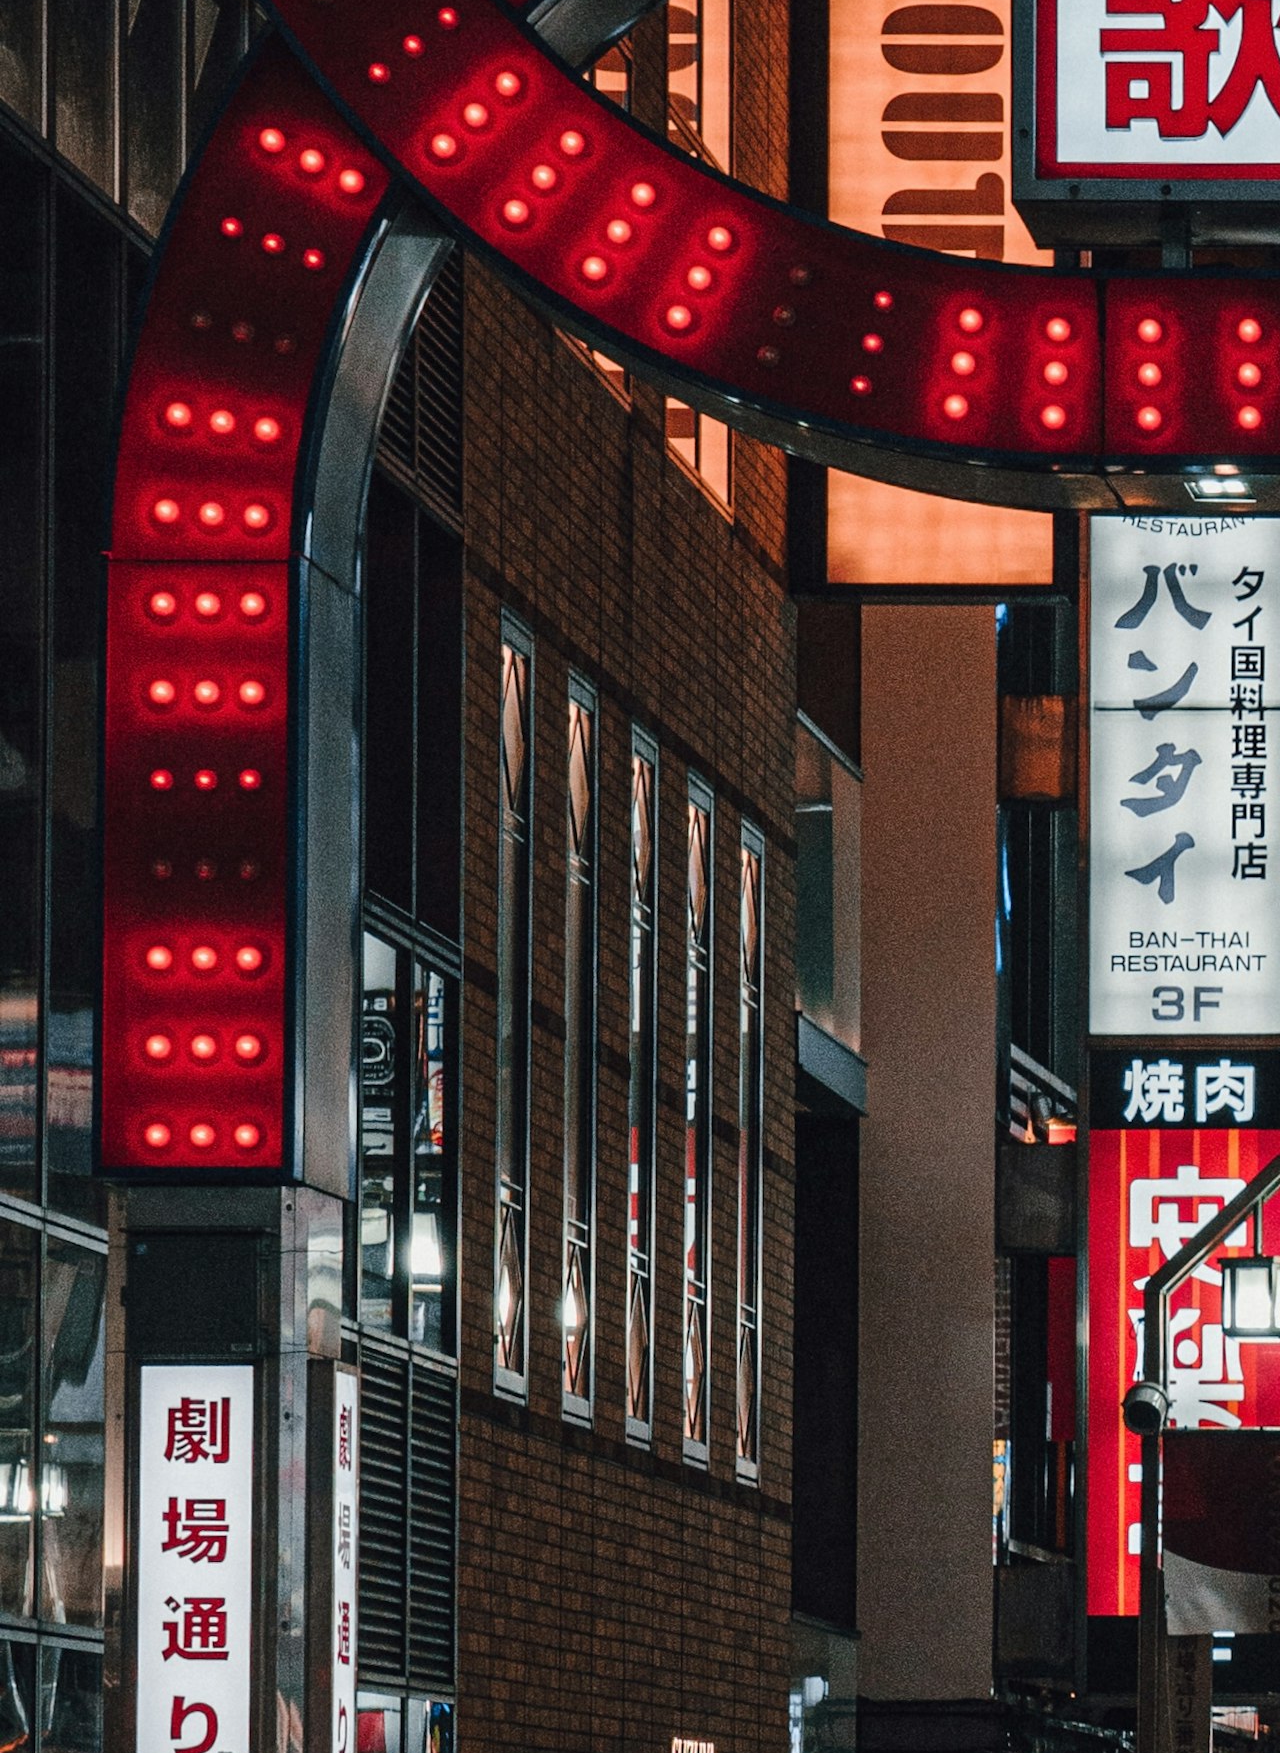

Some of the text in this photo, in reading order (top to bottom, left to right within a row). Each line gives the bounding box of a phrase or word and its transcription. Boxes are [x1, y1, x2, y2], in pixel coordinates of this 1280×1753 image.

[1115, 561, 1213, 905] バンタイ
[1229, 566, 1268, 880] タイ国料理専門店
[1111, 954, 1267, 973] RESTAURANT
[1129, 931, 1250, 949] BAN-THAI
[1151, 986, 1223, 1022] 3F
[1123, 1059, 1256, 1123] 焼肉
